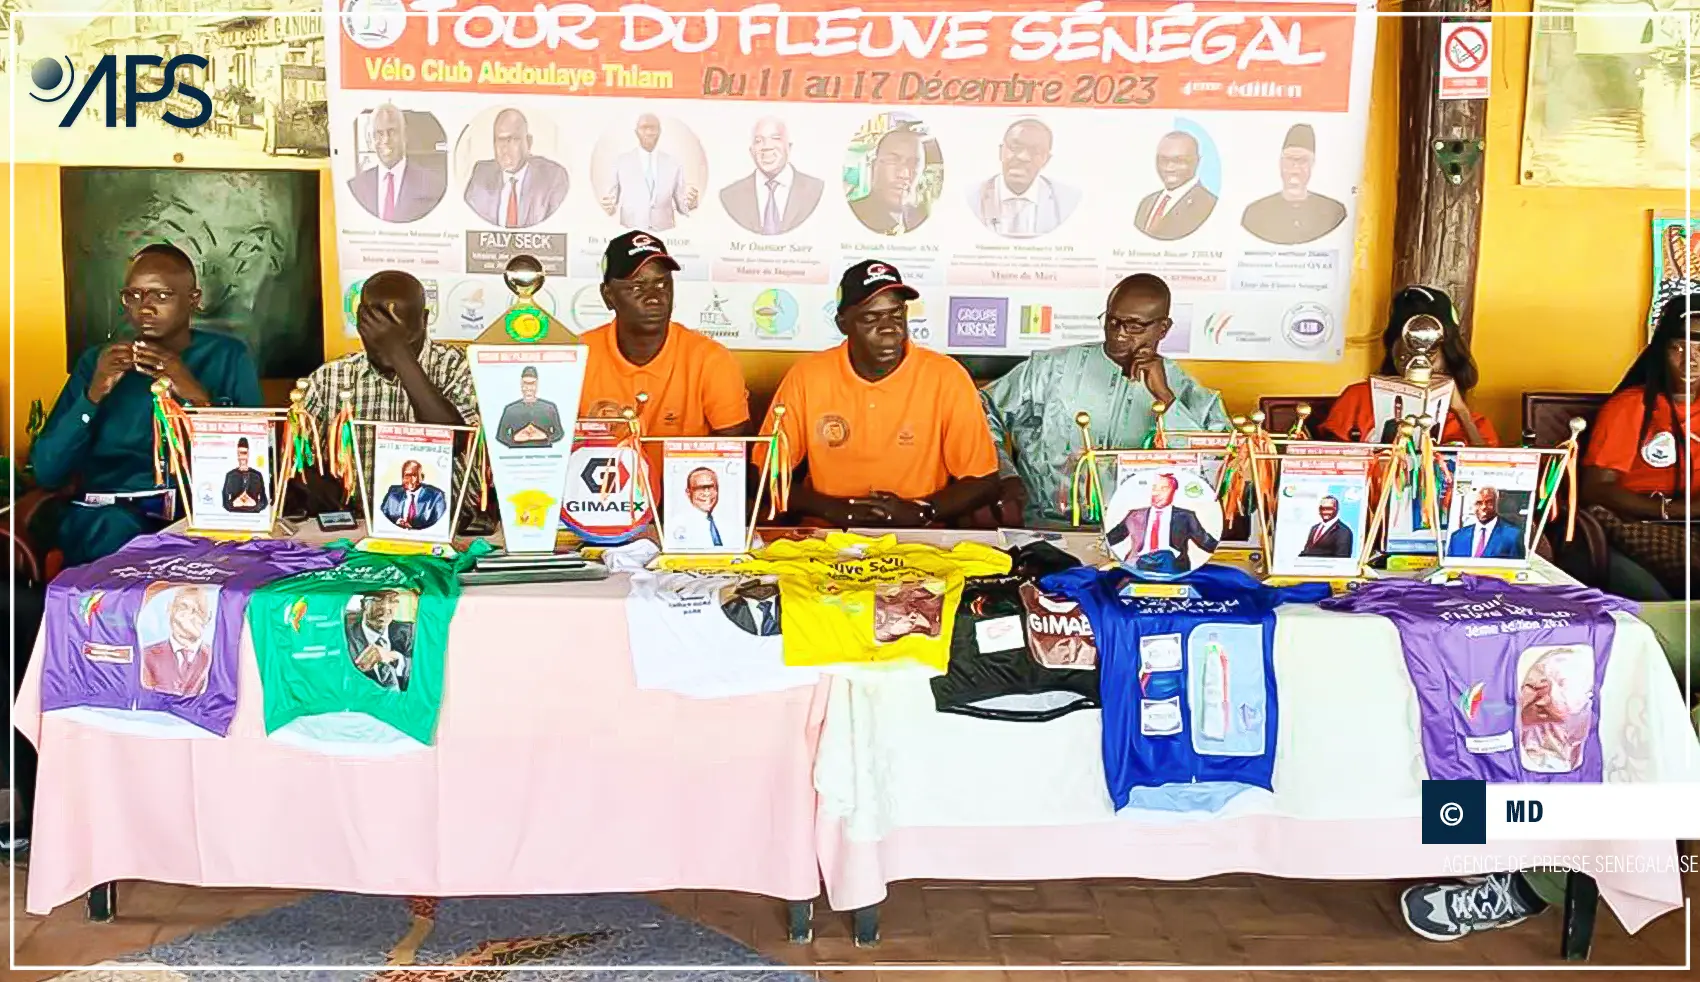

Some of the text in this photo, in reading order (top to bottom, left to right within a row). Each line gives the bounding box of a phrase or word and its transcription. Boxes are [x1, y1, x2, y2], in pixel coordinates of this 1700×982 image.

[410, 0, 600, 50] TOUR
[620, 3, 720, 51] DU
[738, 4, 988, 60] FLEUVE
[1010, 1, 1326, 69] SÉNÉGAL
[365, 57, 673, 91] Vélo Club Abdoulaye Thiam
[703, 66, 1159, 104] Du 11 au 17 Décembre 2023
[479, 232, 552, 249] FALY SECK
[566, 501, 644, 513] GIMAEX
[1028, 612, 1094, 637] GIMAE
